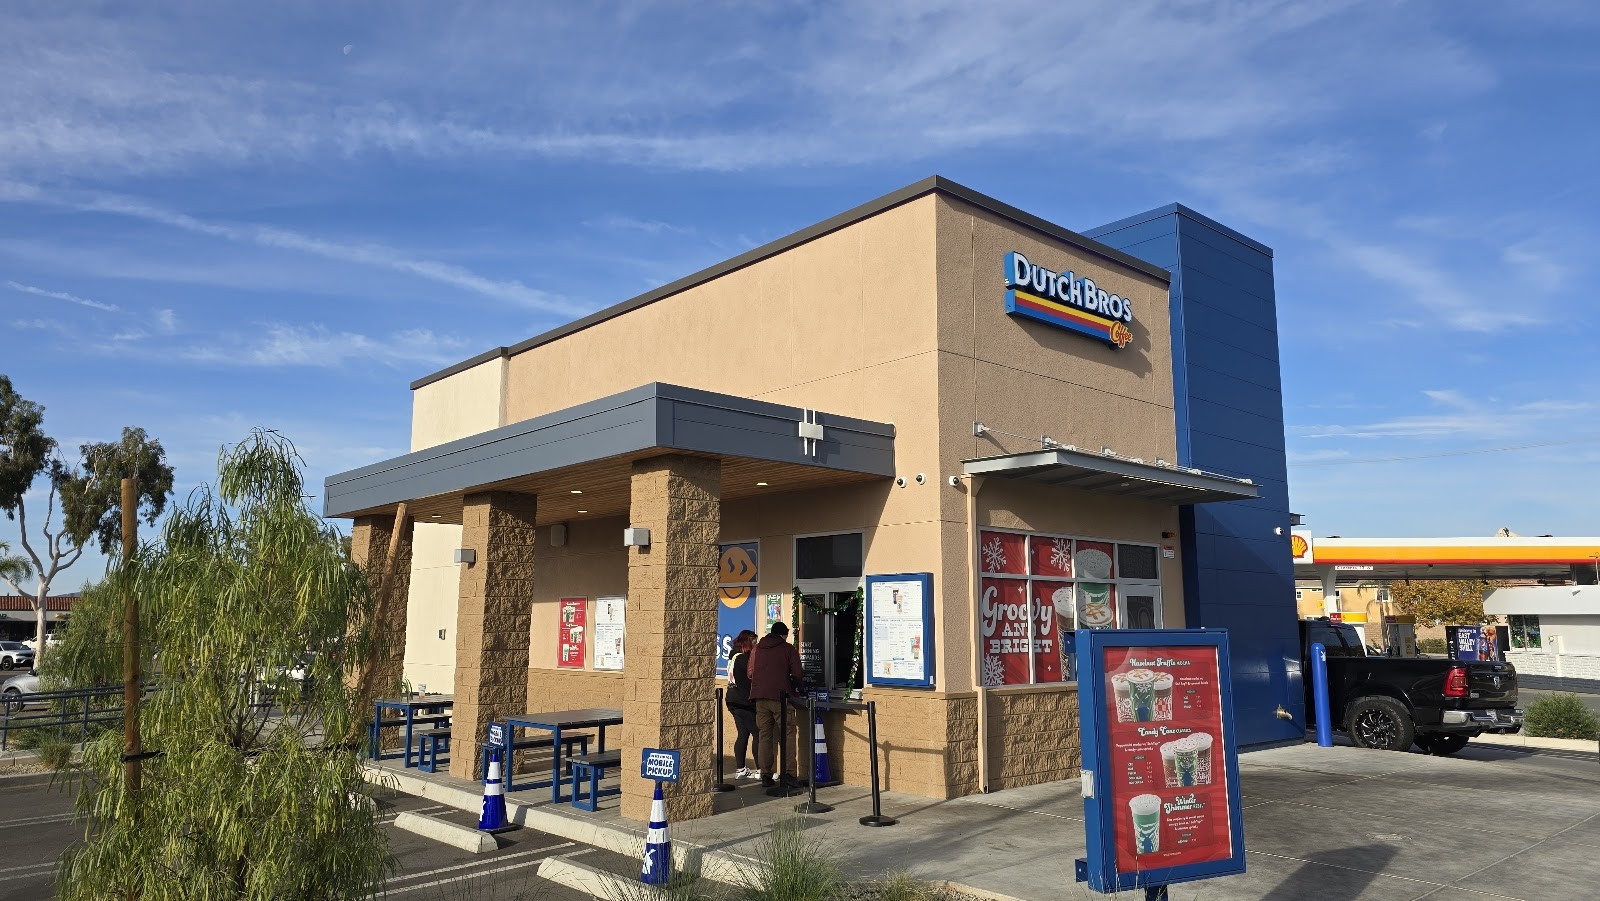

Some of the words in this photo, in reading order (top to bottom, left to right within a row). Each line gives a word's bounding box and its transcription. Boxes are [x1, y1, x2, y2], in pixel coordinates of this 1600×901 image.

[1084, 277, 1133, 322] BROS
[1110, 321, 1133, 348] Coffee
[989, 638, 1053, 654] BRIGHT
[1138, 726, 1159, 738] Candy
[1159, 726, 1176, 736] Cane
[647, 758, 674, 768] MOBILE
[647, 766, 673, 776] PICKUP
